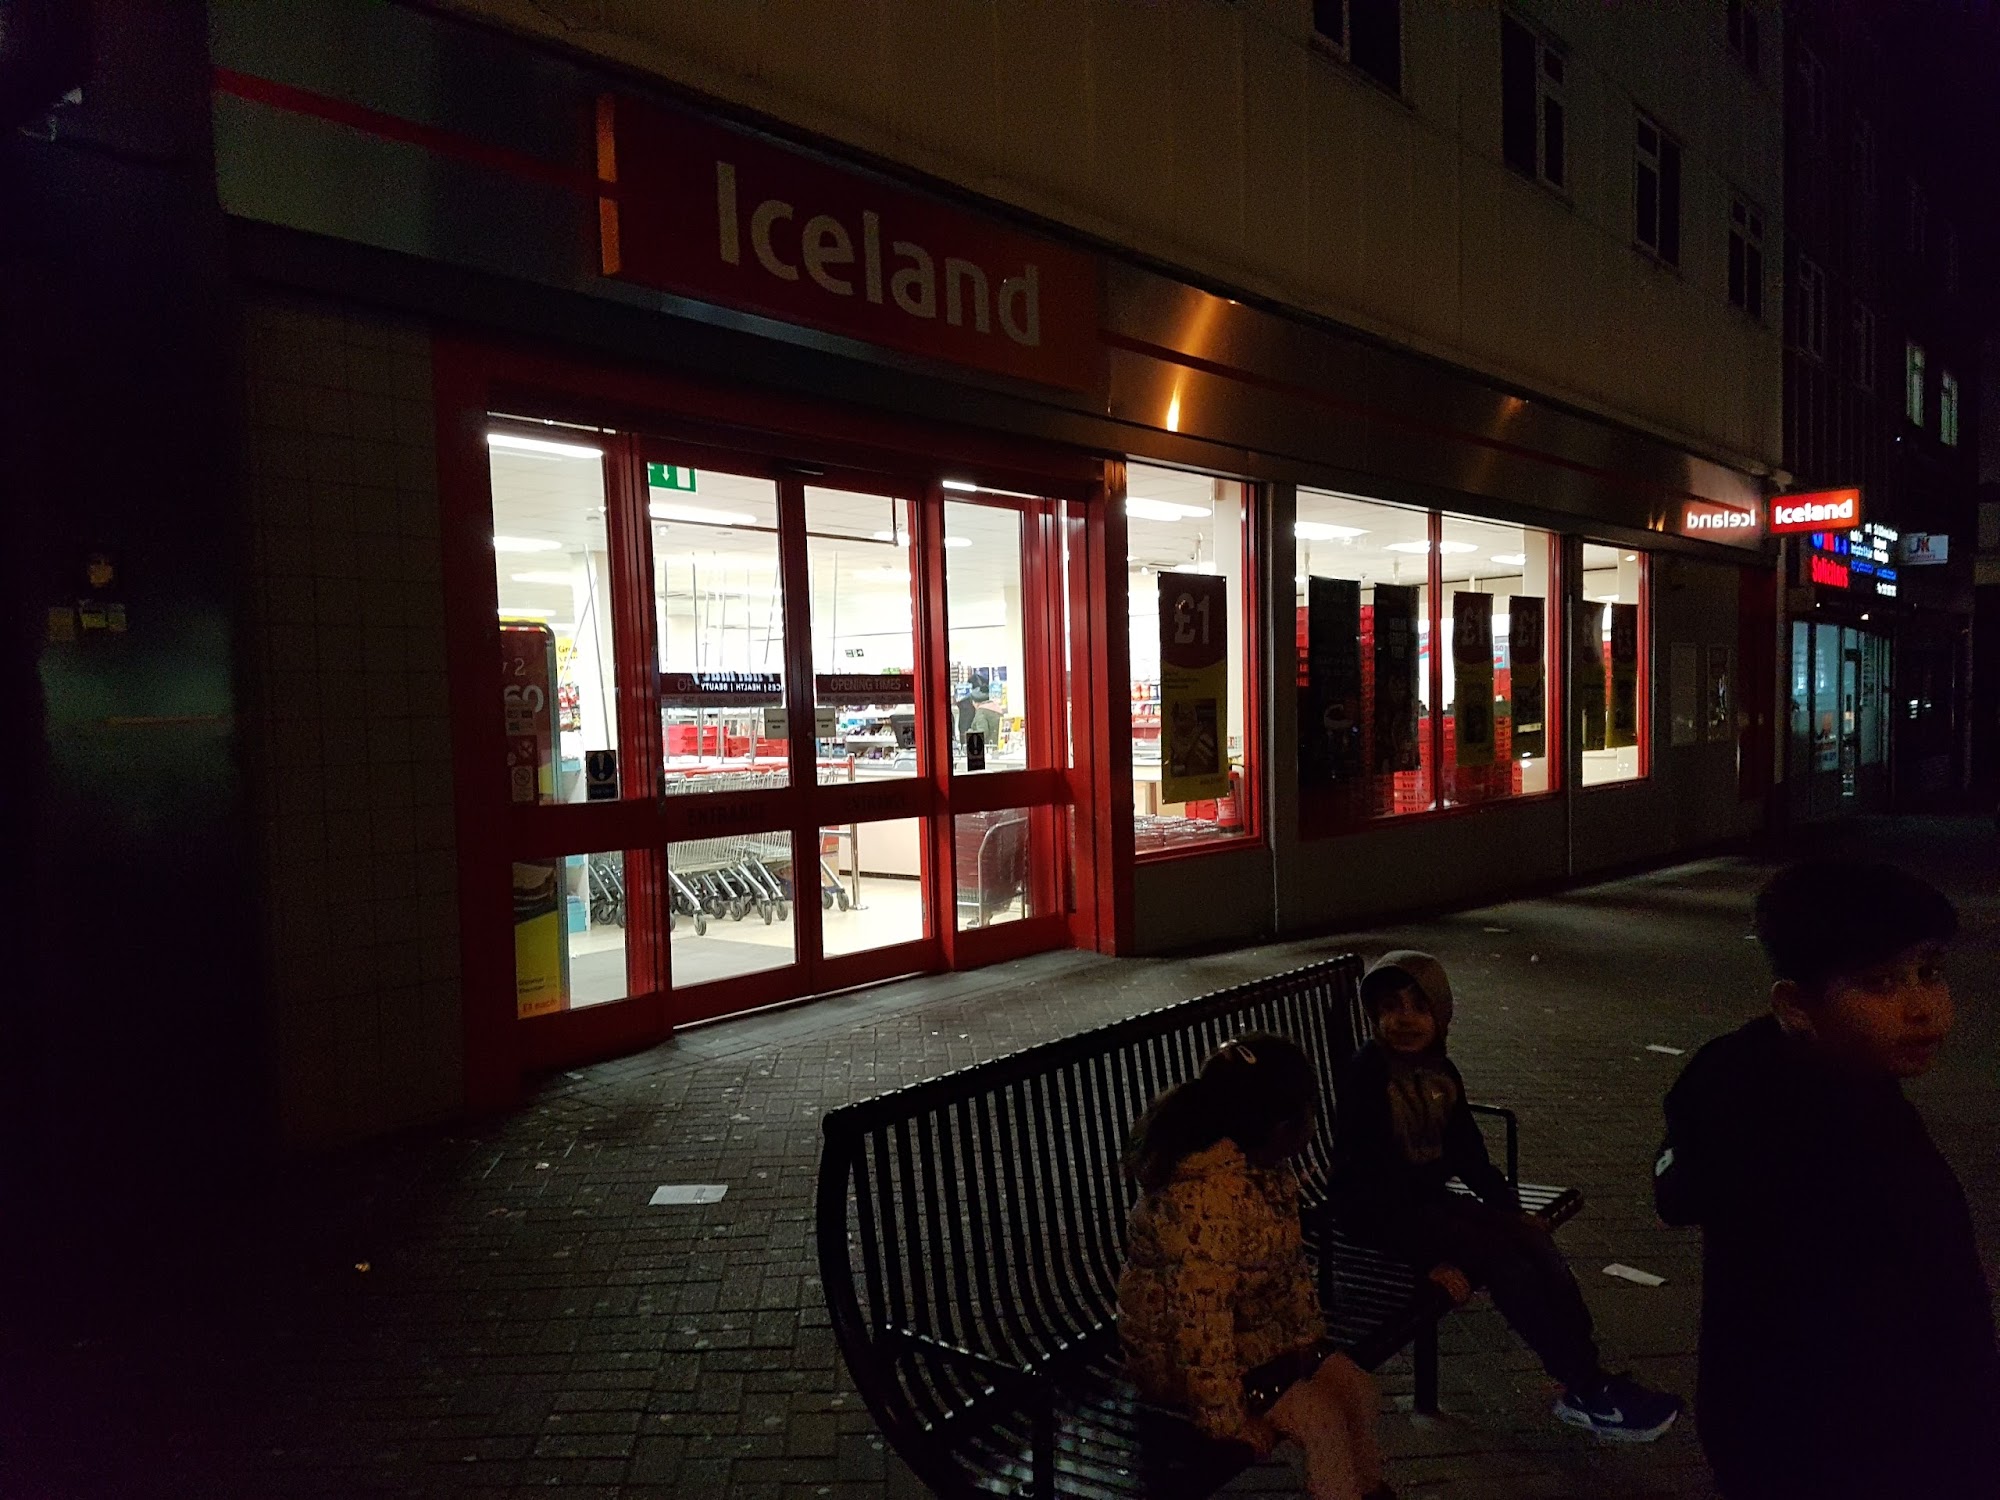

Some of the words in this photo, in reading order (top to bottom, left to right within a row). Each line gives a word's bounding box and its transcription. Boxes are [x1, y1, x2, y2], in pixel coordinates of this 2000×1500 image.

[715, 160, 1042, 347] Iceland
[1775, 498, 1853, 525] Iceland
[1812, 555, 1848, 588] Solicitors
[1174, 592, 1211, 645] £1
[831, 678, 873, 691] OPENING
[875, 678, 901, 690] TIMES
